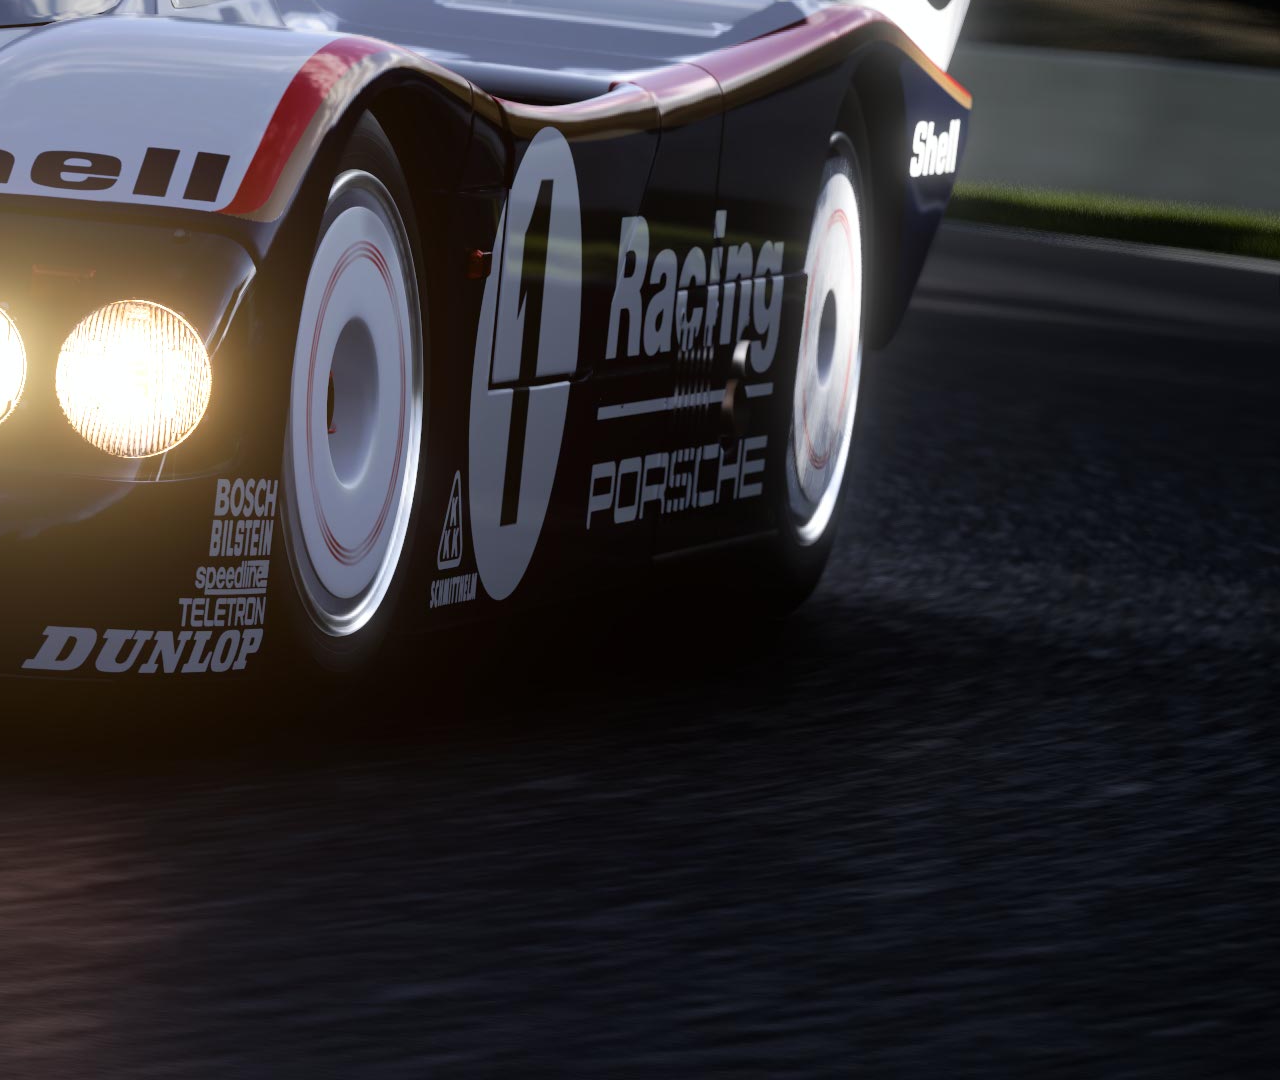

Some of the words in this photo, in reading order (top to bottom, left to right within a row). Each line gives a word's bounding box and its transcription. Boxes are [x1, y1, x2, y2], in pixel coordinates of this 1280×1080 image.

[909, 118, 962, 178] Shell
[605, 209, 785, 374] Racing
[500, 178, 555, 527] 1
[214, 478, 279, 517] BOSCH
[586, 435, 769, 530] PORSCHE
[209, 519, 275, 557] BILSTEIN
[195, 560, 270, 590] speedline
[179, 597, 267, 627] TELETRON
[21, 625, 264, 674] DUNLOP
